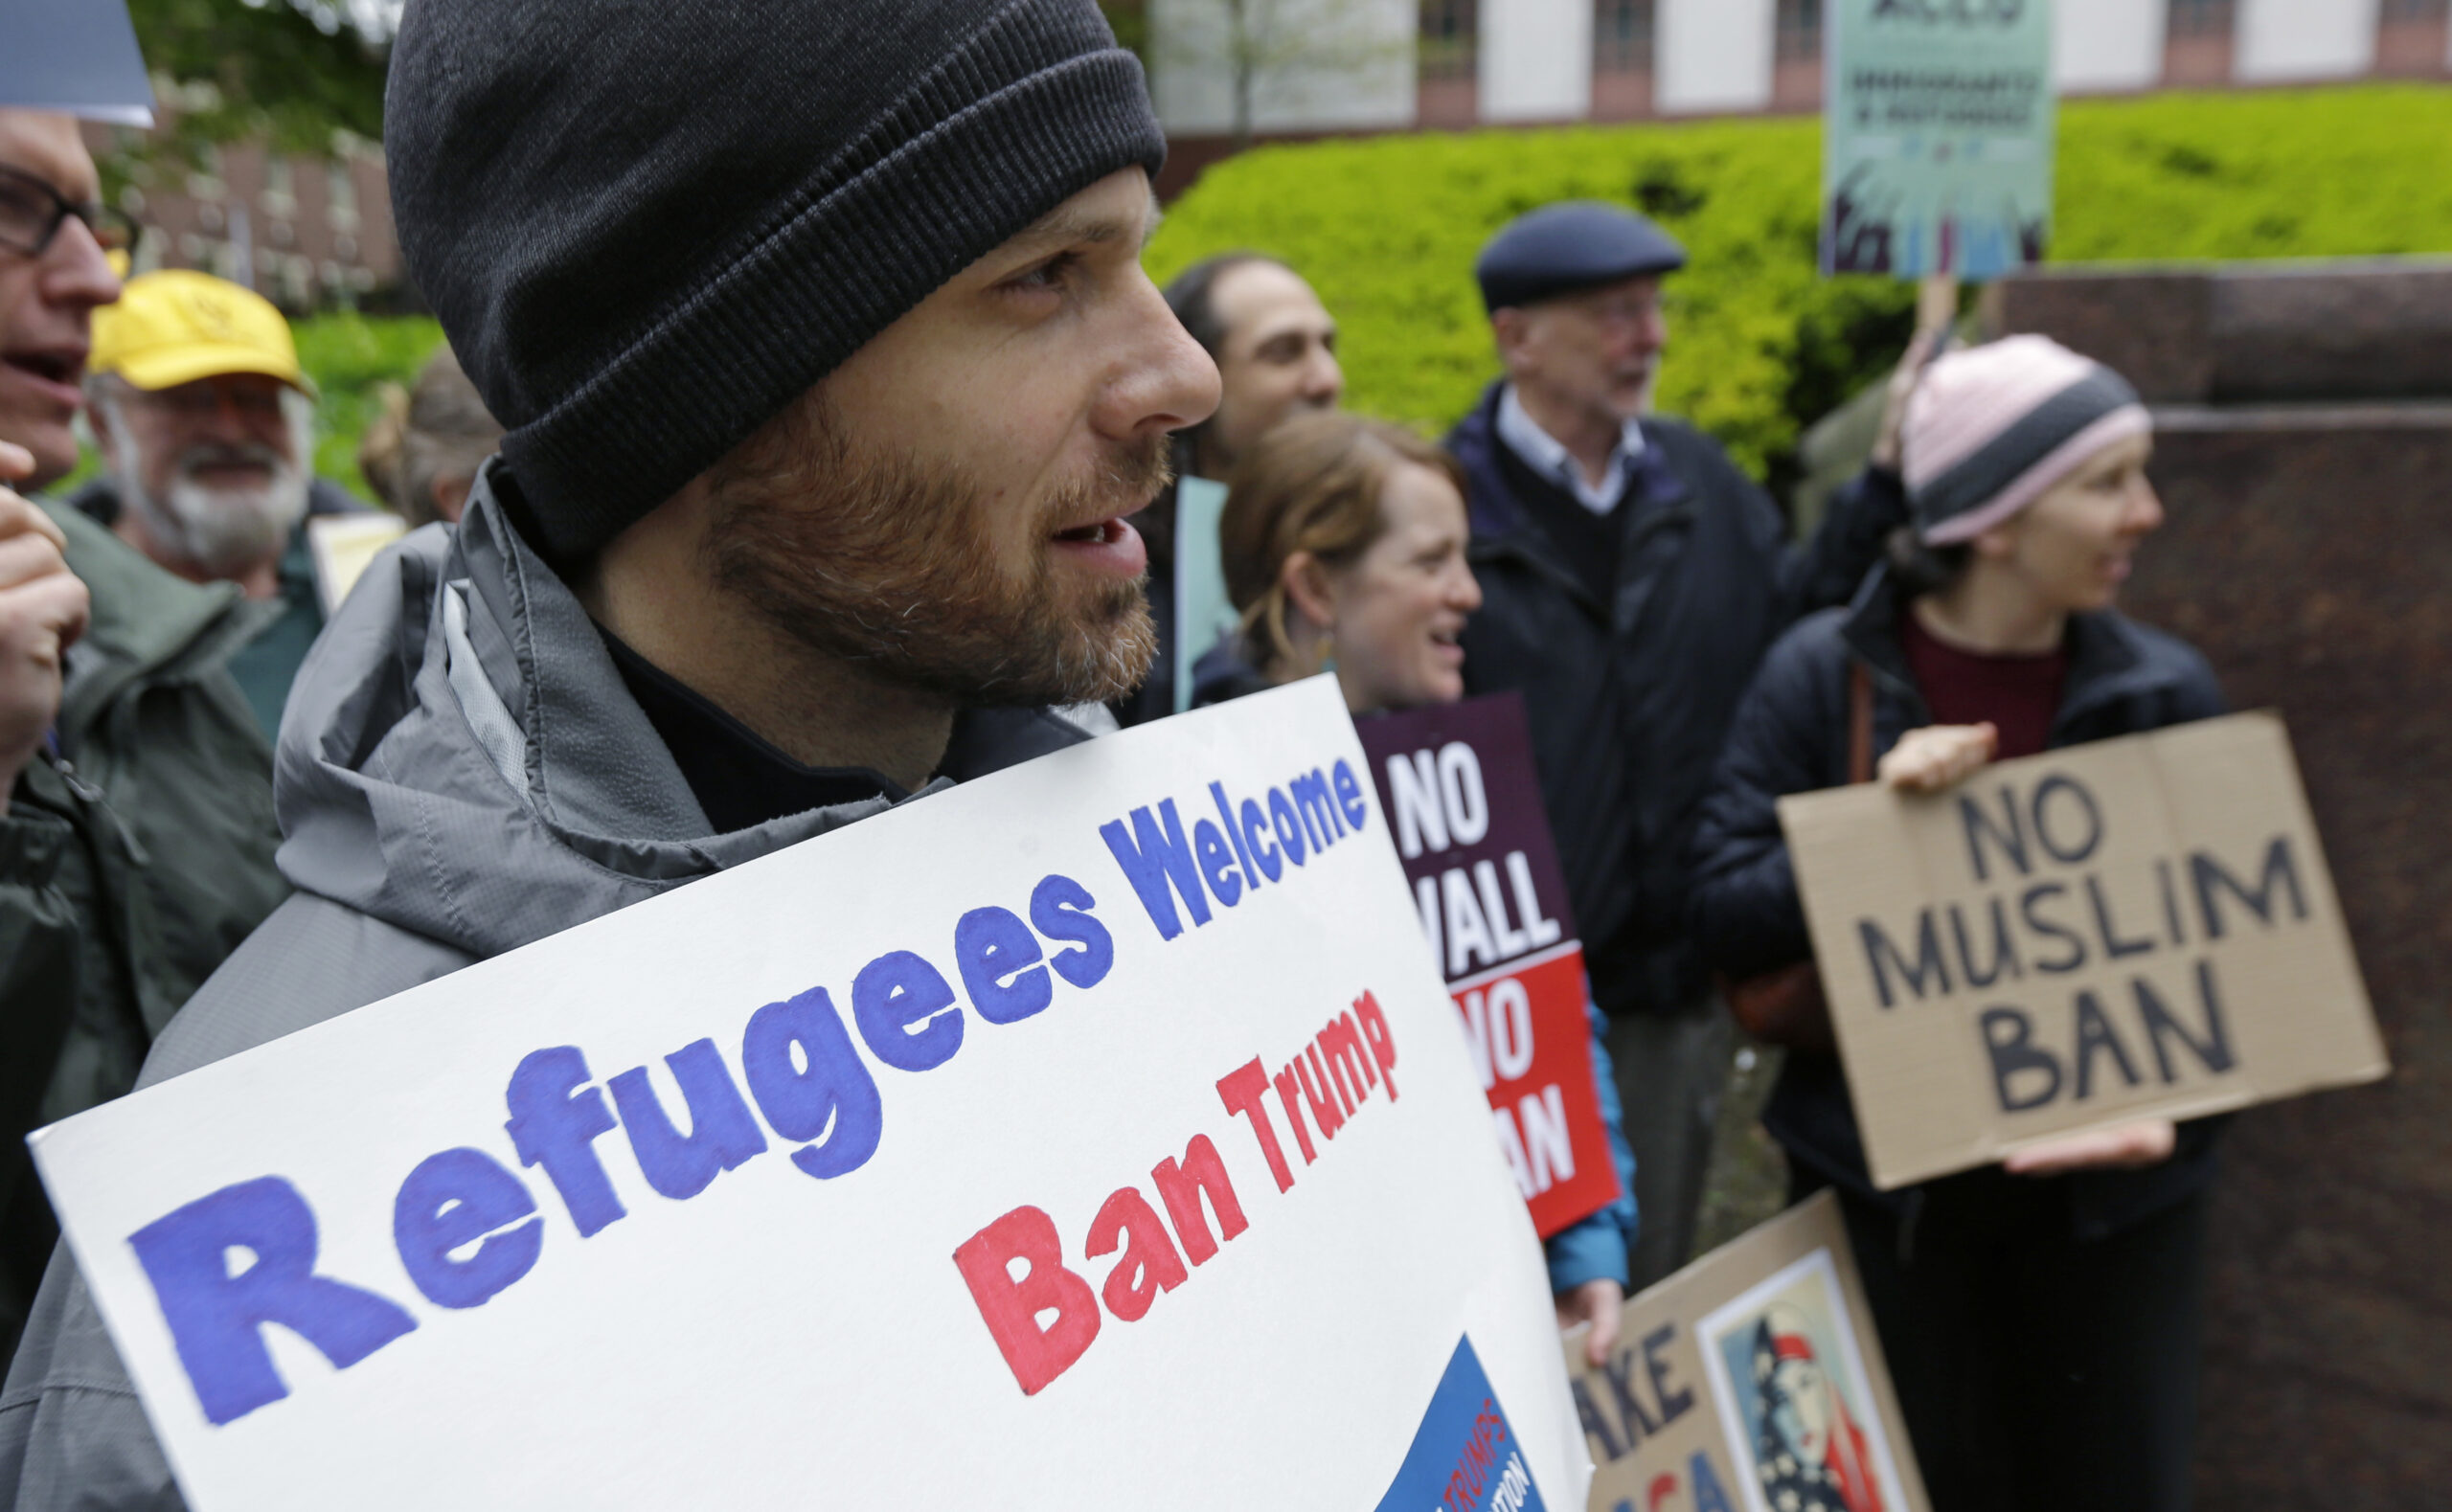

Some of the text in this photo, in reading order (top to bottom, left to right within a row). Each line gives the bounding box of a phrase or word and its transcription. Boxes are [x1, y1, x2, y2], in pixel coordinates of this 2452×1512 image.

[1386, 741, 1489, 859] NO
[1956, 768, 2102, 881] NO
[1858, 835, 2309, 1009] MUSLIM
[127, 759, 1366, 1427] Refugees Welcome
[1978, 959, 2238, 1114] BAN
[955, 991, 1396, 1394] Ban Trump
[1493, 1082, 1576, 1201] AN
[1443, 1398, 1506, 1512] TRUMPS
[1572, 1321, 1695, 1463] AKE
